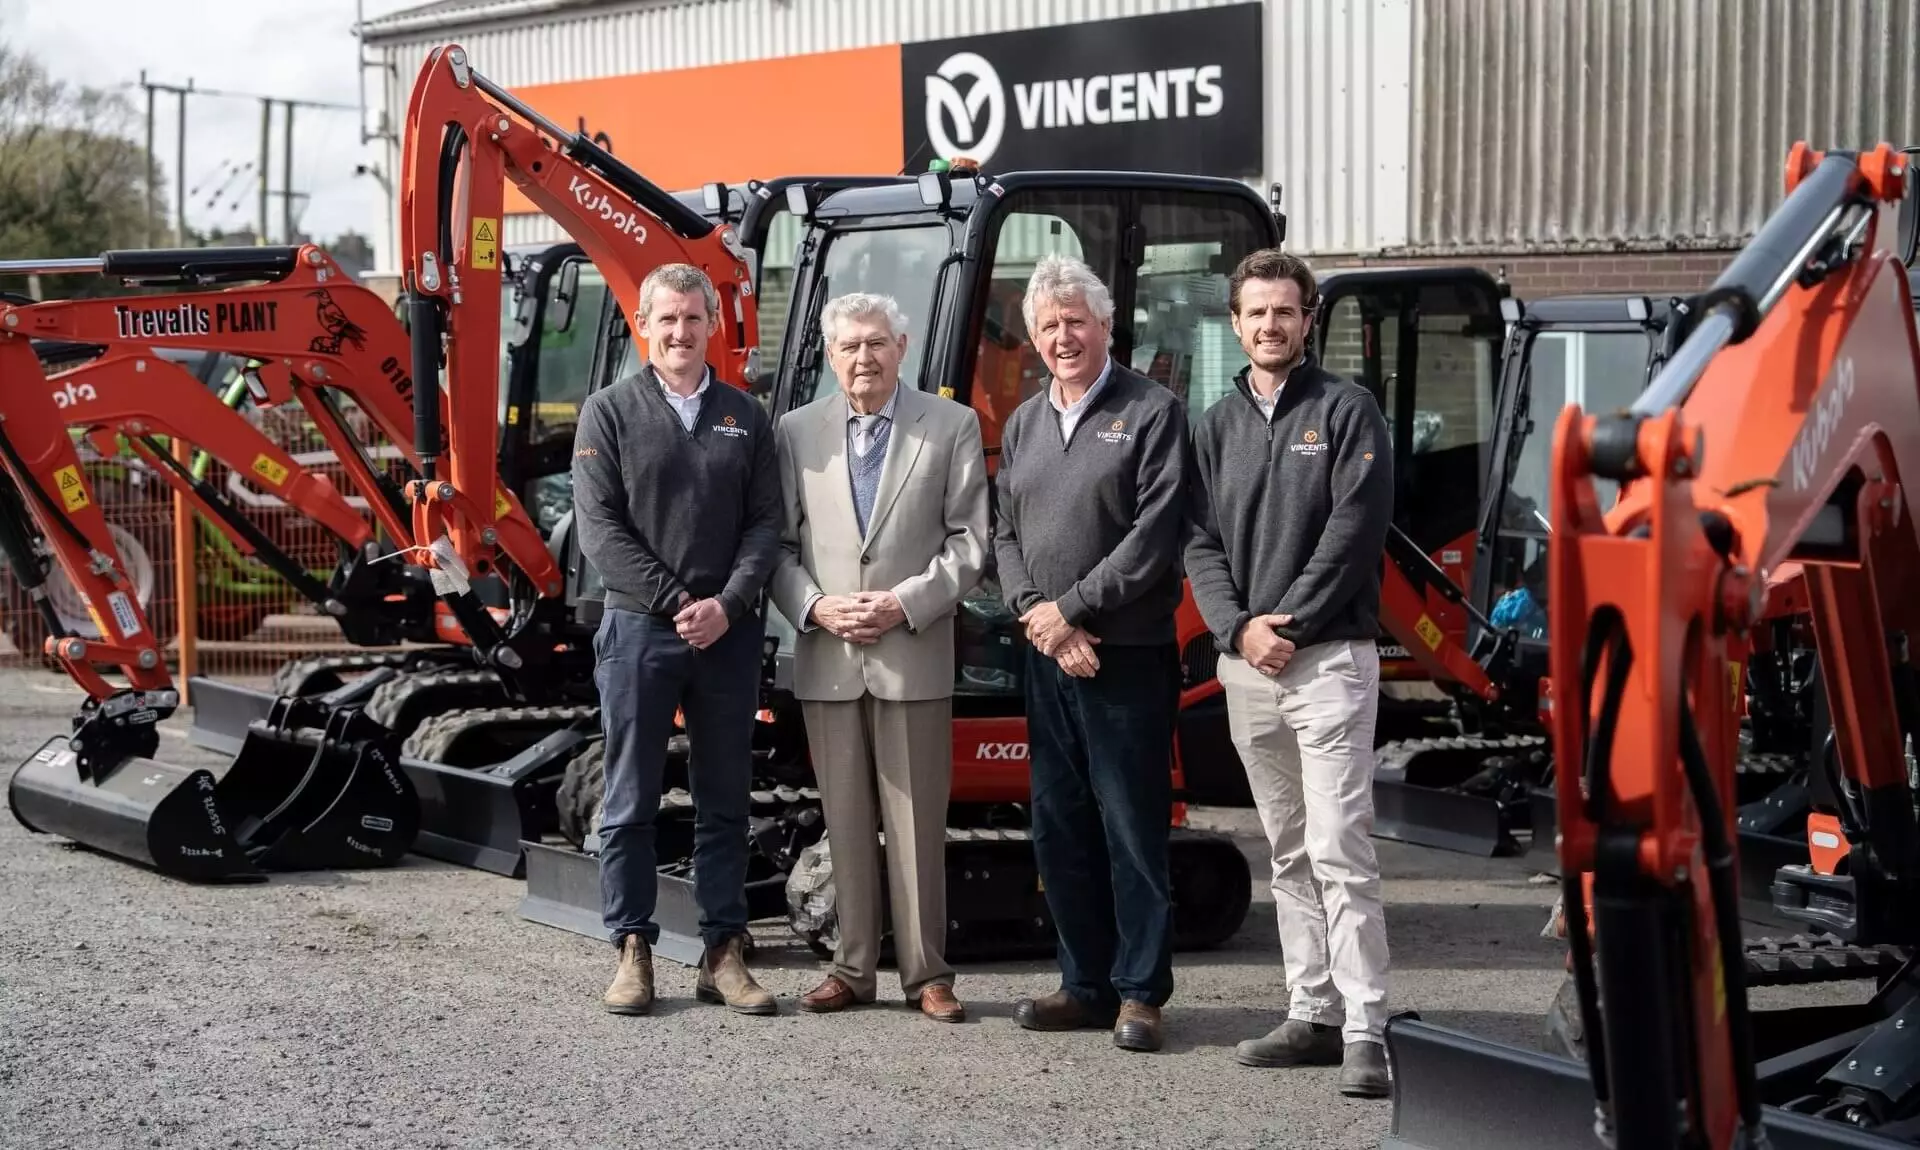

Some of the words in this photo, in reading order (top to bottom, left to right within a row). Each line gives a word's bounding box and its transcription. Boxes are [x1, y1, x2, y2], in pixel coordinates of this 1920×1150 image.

[1013, 64, 1224, 130] VINCENTS
[568, 174, 648, 246] Kubota
[114, 303, 210, 338] Trevails
[216, 302, 278, 334] PLANT
[52, 381, 97, 409] ota
[712, 424, 748, 436] VINCENTS
[1097, 431, 1133, 441] VINCENTS
[1792, 355, 1854, 492] Kubota
[1290, 442, 1328, 452] VINCENTS
